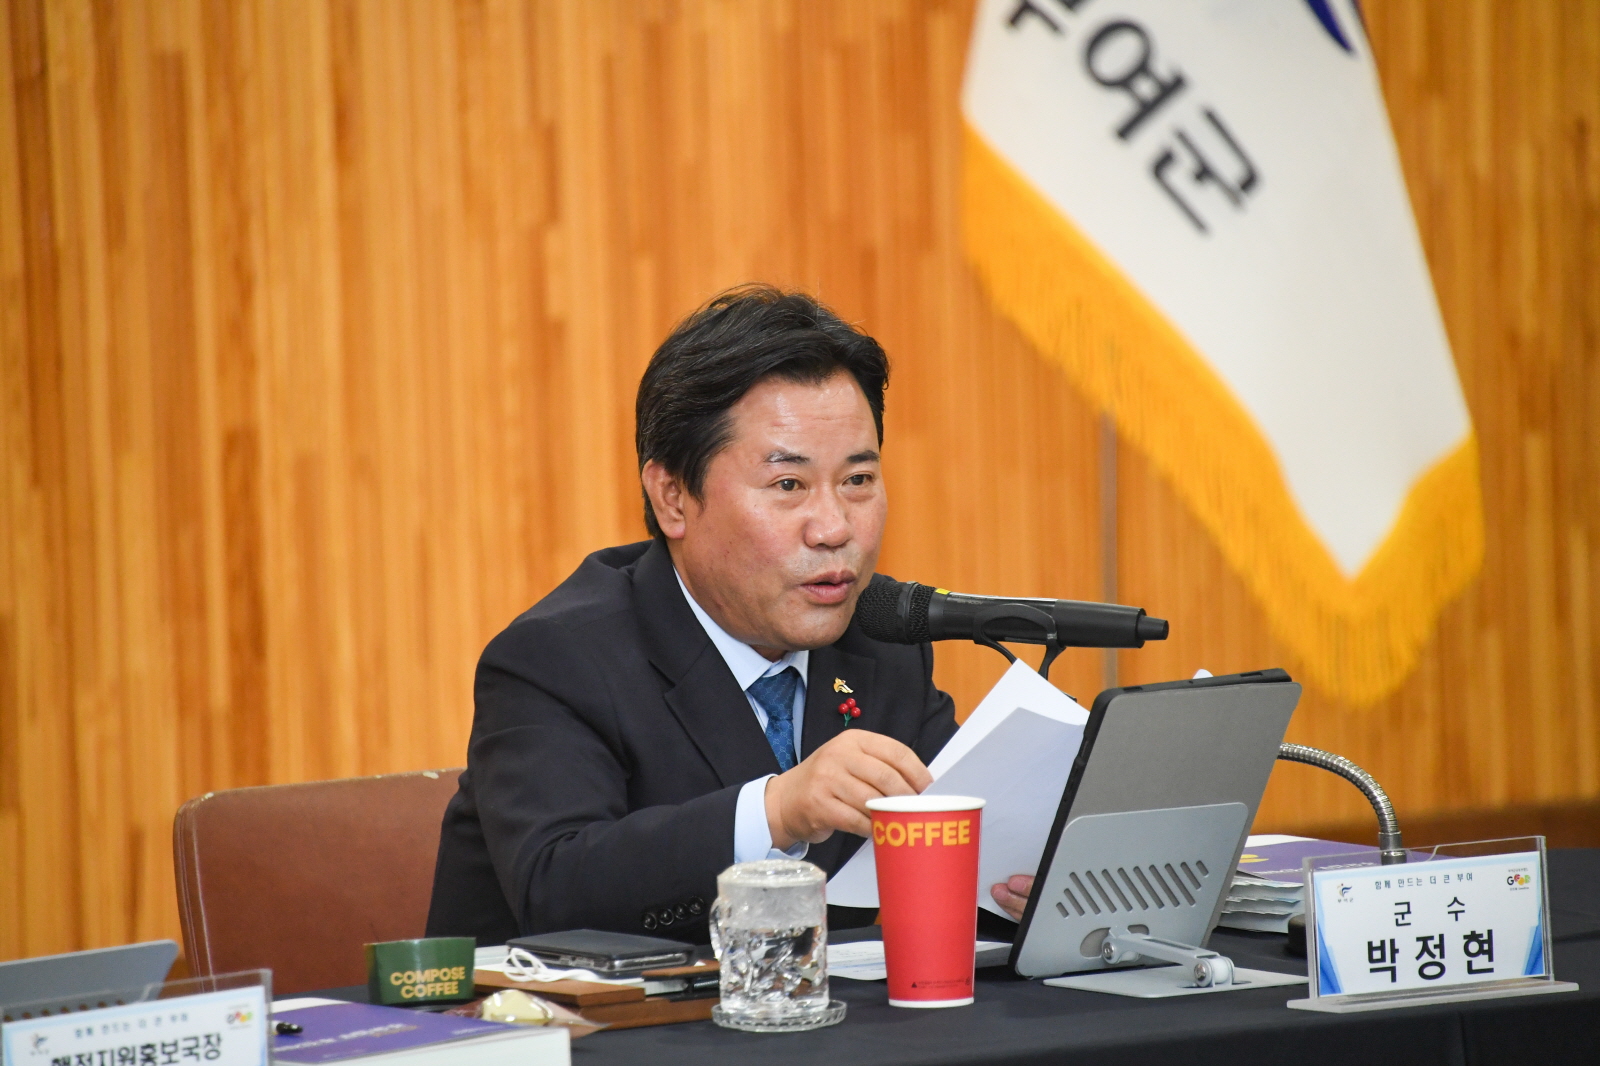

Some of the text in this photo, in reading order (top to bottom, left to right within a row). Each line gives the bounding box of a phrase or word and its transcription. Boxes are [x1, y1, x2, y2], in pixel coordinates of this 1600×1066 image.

[873, 819, 971, 847] COFFEE
[1397, 877, 1423, 888] 만드는
[1429, 875, 1437, 885] 더
[1443, 874, 1451, 884] 큰
[1457, 872, 1473, 882] 부여
[390, 966, 466, 986] COMPOSE
[401, 981, 459, 999] COFFEE
